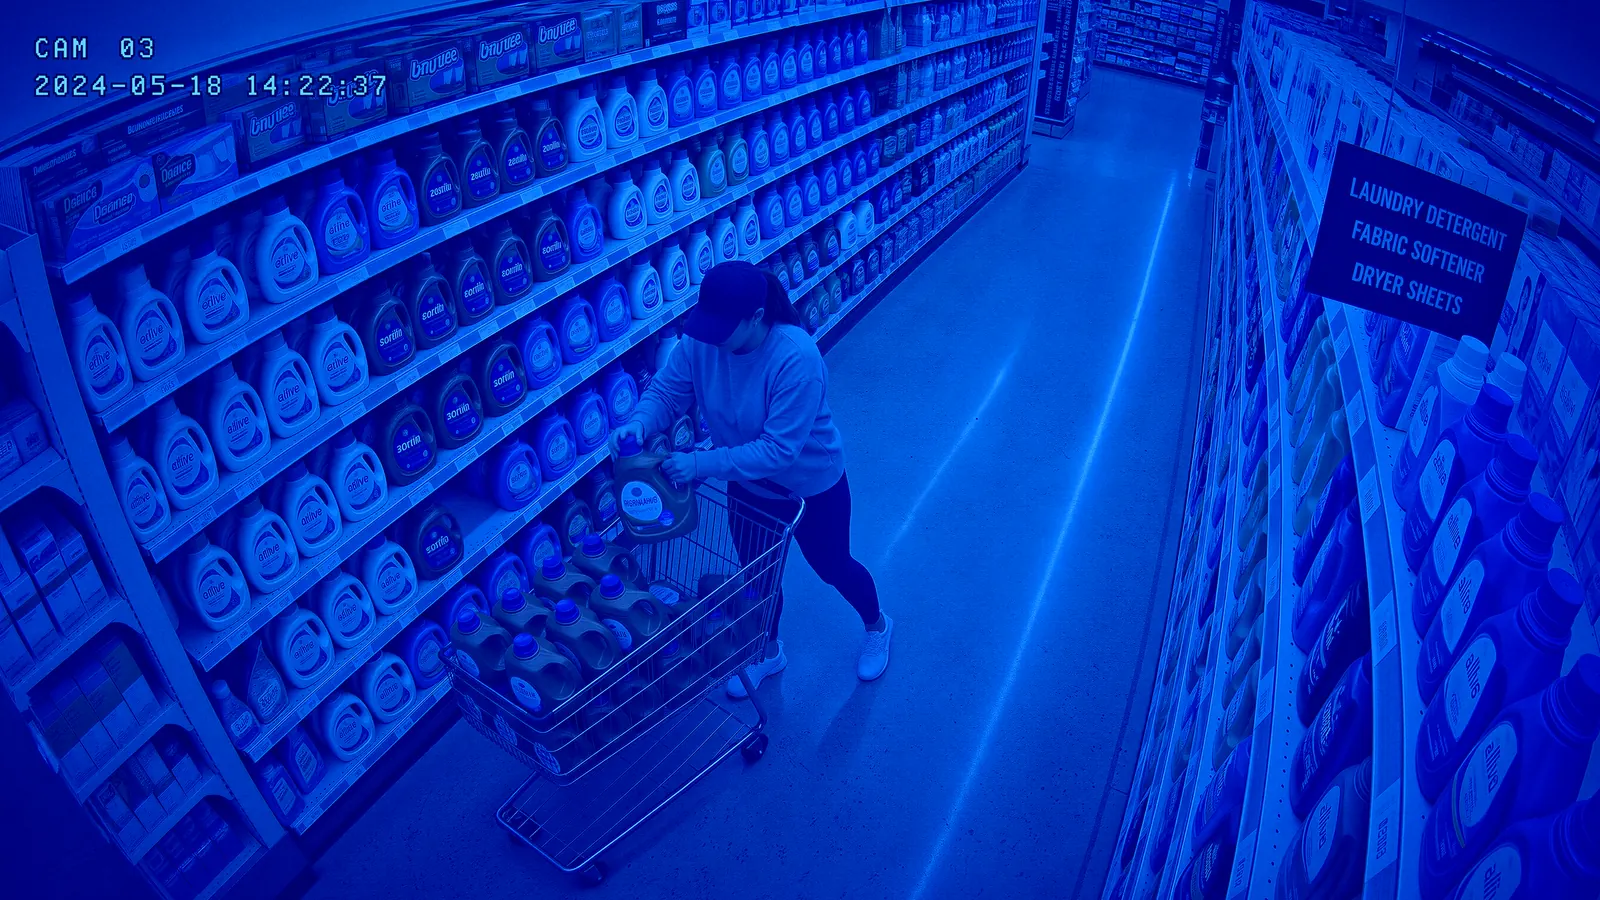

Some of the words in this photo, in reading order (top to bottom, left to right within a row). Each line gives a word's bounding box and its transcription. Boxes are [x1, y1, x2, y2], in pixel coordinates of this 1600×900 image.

[1349, 177, 1425, 220] LAUNDRY
[1425, 204, 1508, 253] DETERGENT
[1351, 220, 1407, 256] FABRIC
[1411, 241, 1485, 284] SOFTENER
[1351, 262, 1404, 296] DRYER
[1407, 280, 1463, 315] SHEETS
